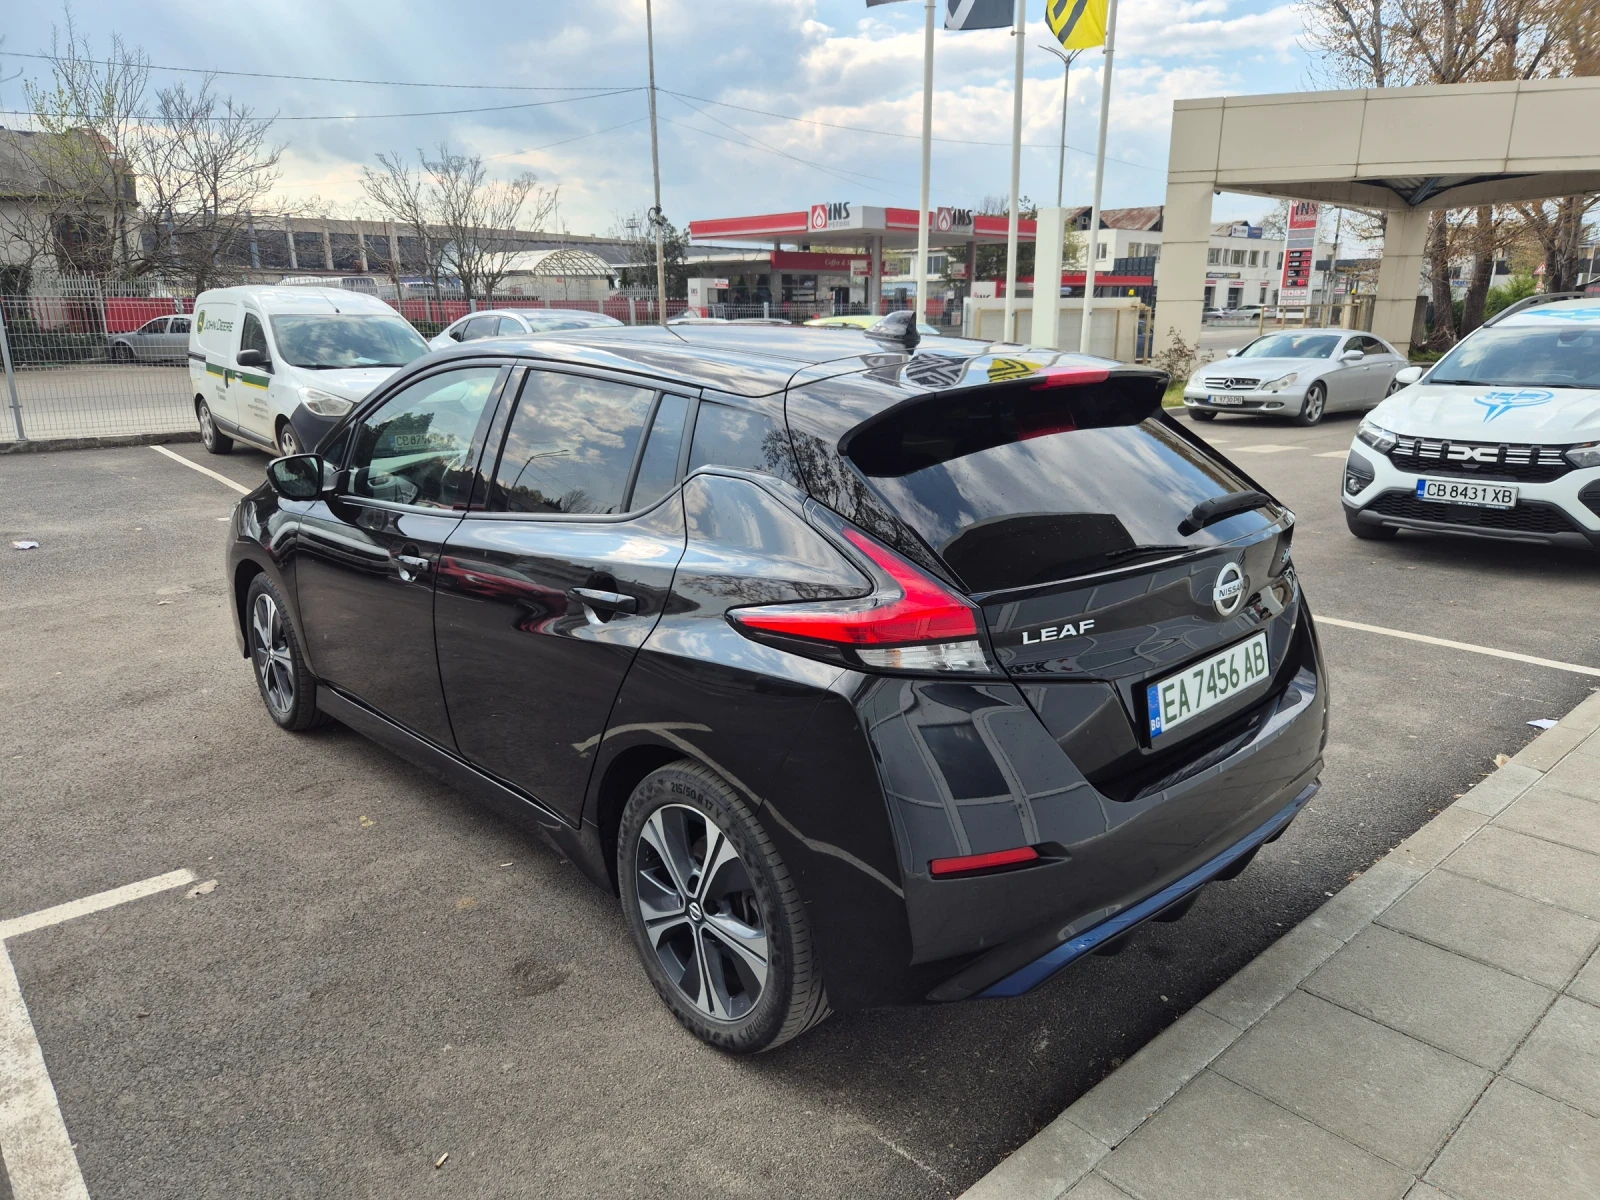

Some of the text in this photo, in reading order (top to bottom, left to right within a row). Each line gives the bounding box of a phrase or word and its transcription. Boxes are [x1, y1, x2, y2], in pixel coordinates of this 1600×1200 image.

[828, 201, 850, 221] INS
[952, 208, 973, 226] INS
[204, 318, 234, 332] JOHN DEERE
[1427, 483, 1447, 497] CB
[1449, 485, 1487, 501] 8431
[1491, 489, 1512, 504] XB
[1022, 619, 1095, 645] LEAF
[1150, 641, 1265, 731] BG EA 7456 AB
